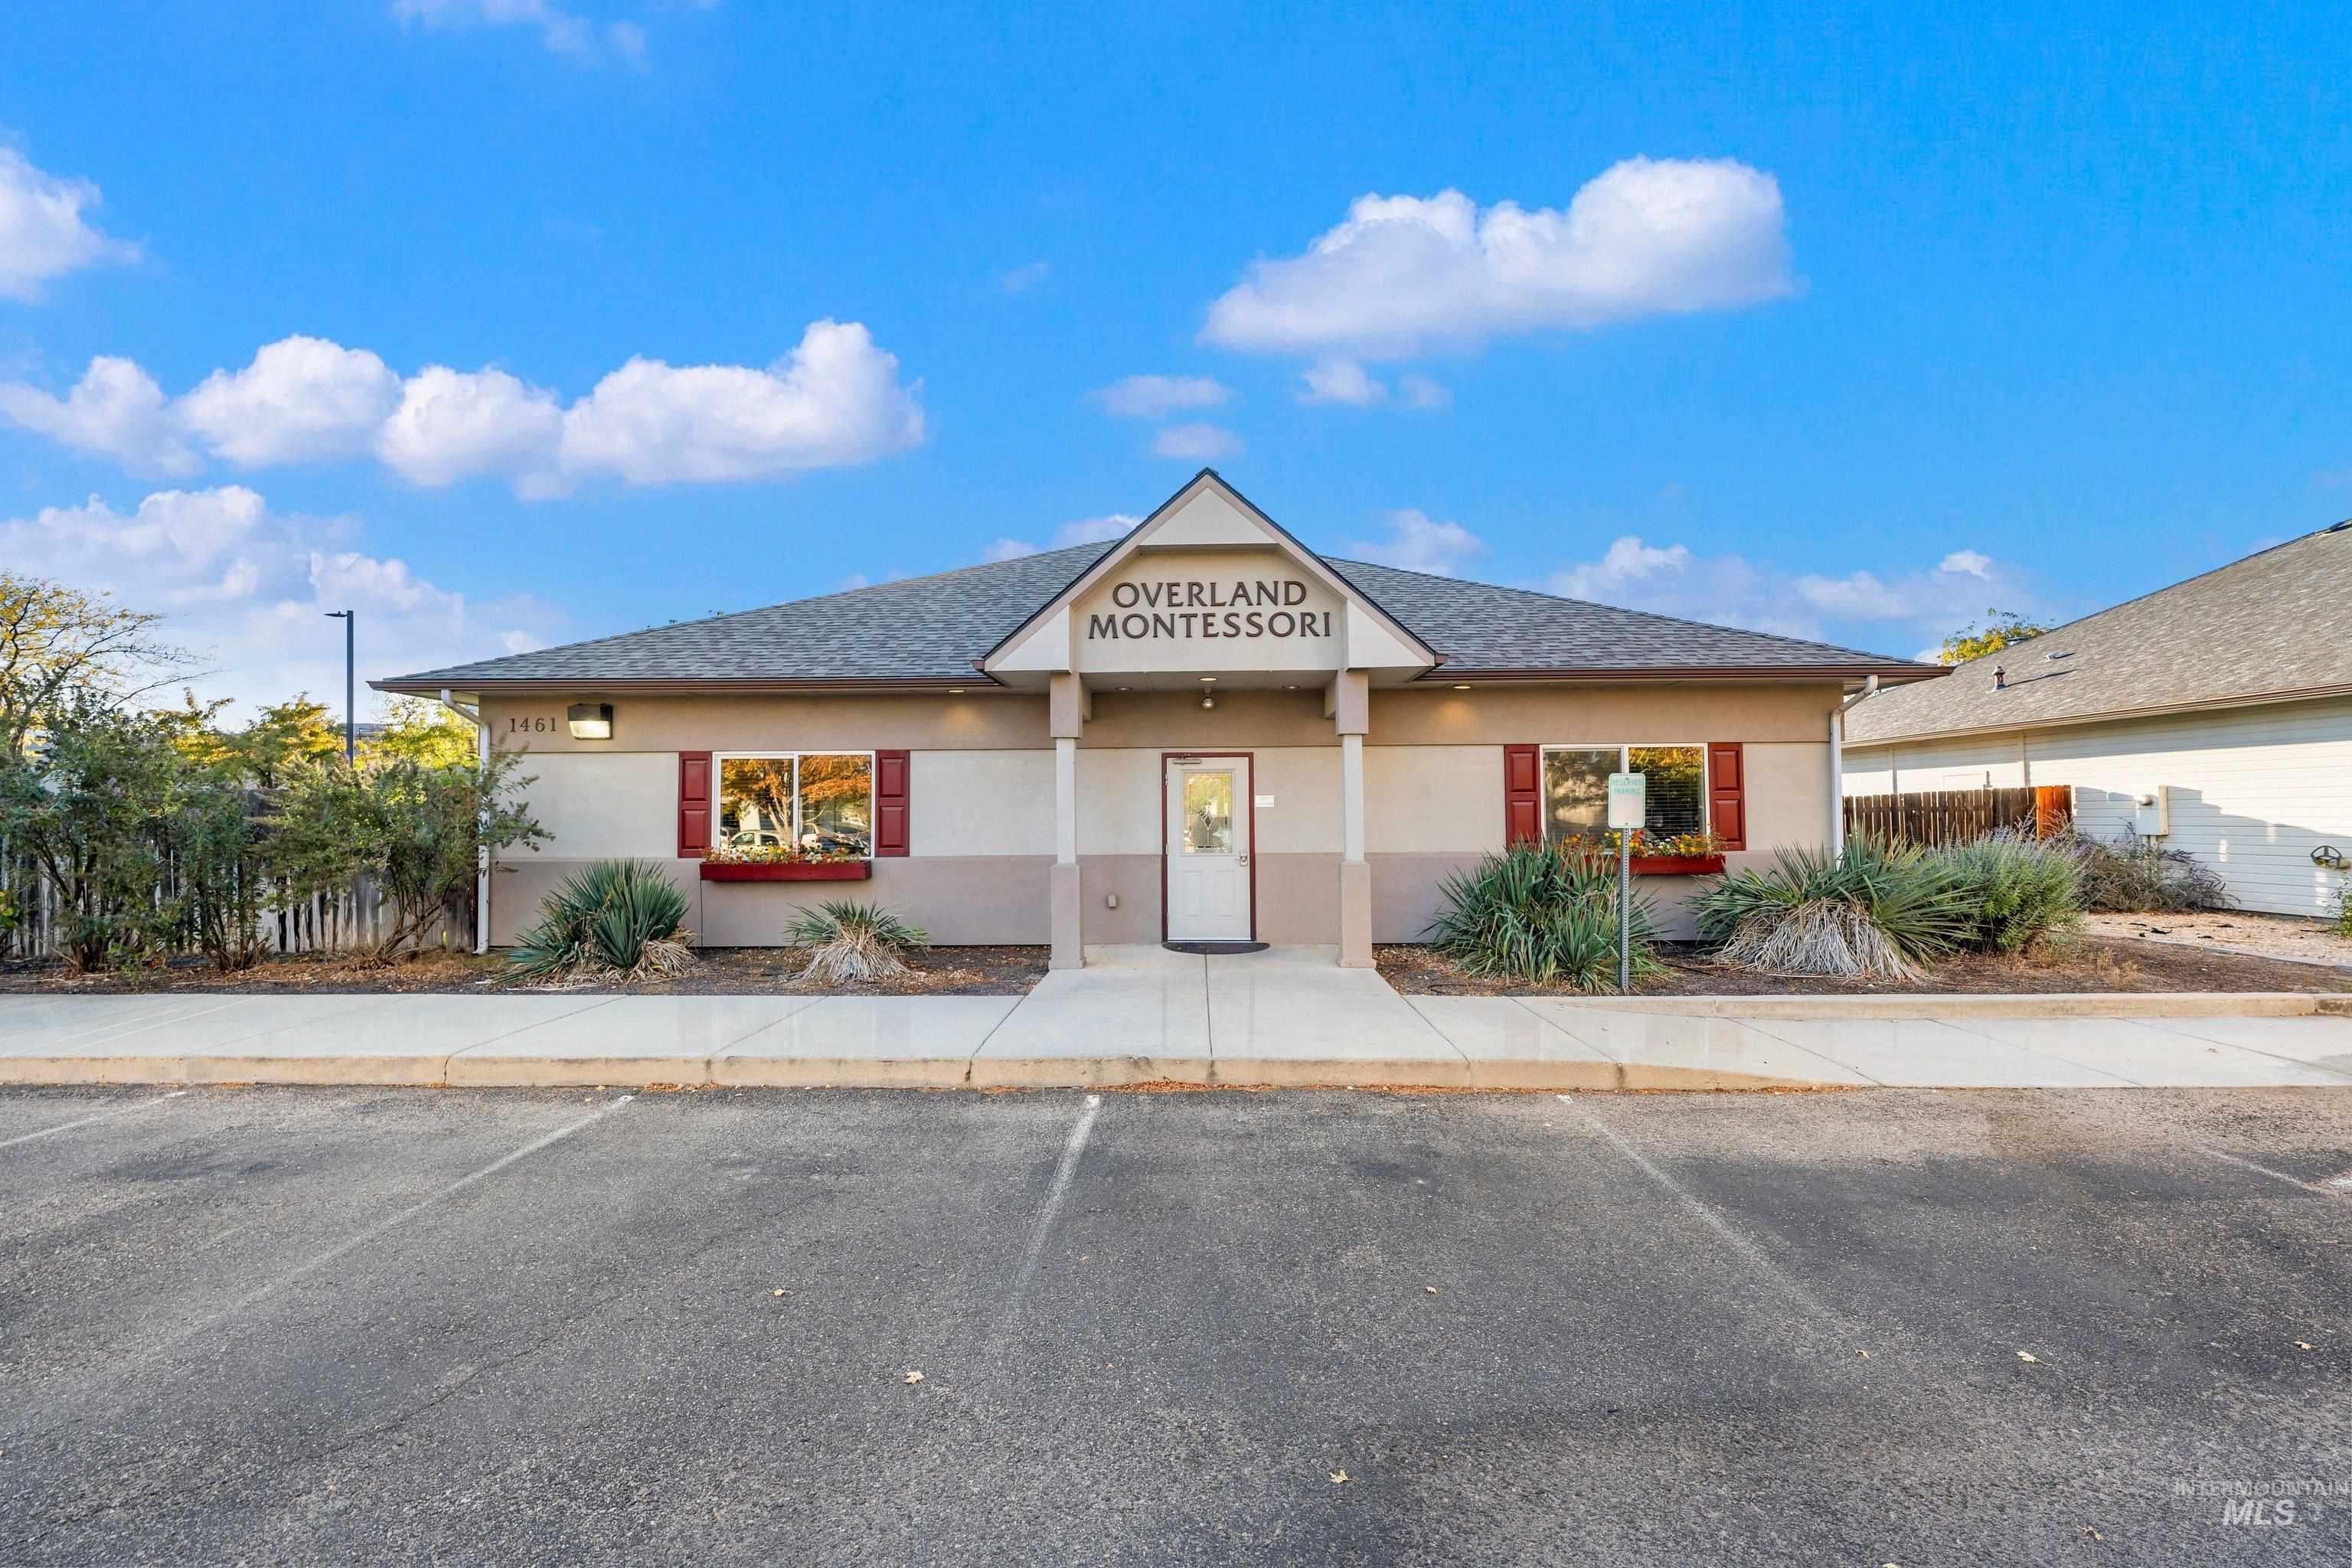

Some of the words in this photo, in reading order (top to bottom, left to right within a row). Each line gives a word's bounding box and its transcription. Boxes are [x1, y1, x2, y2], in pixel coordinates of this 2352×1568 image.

[1112, 580, 1307, 608] OVERLAND
[1088, 611, 1331, 639] MONTESSORI
[508, 717, 557, 733] 1461
